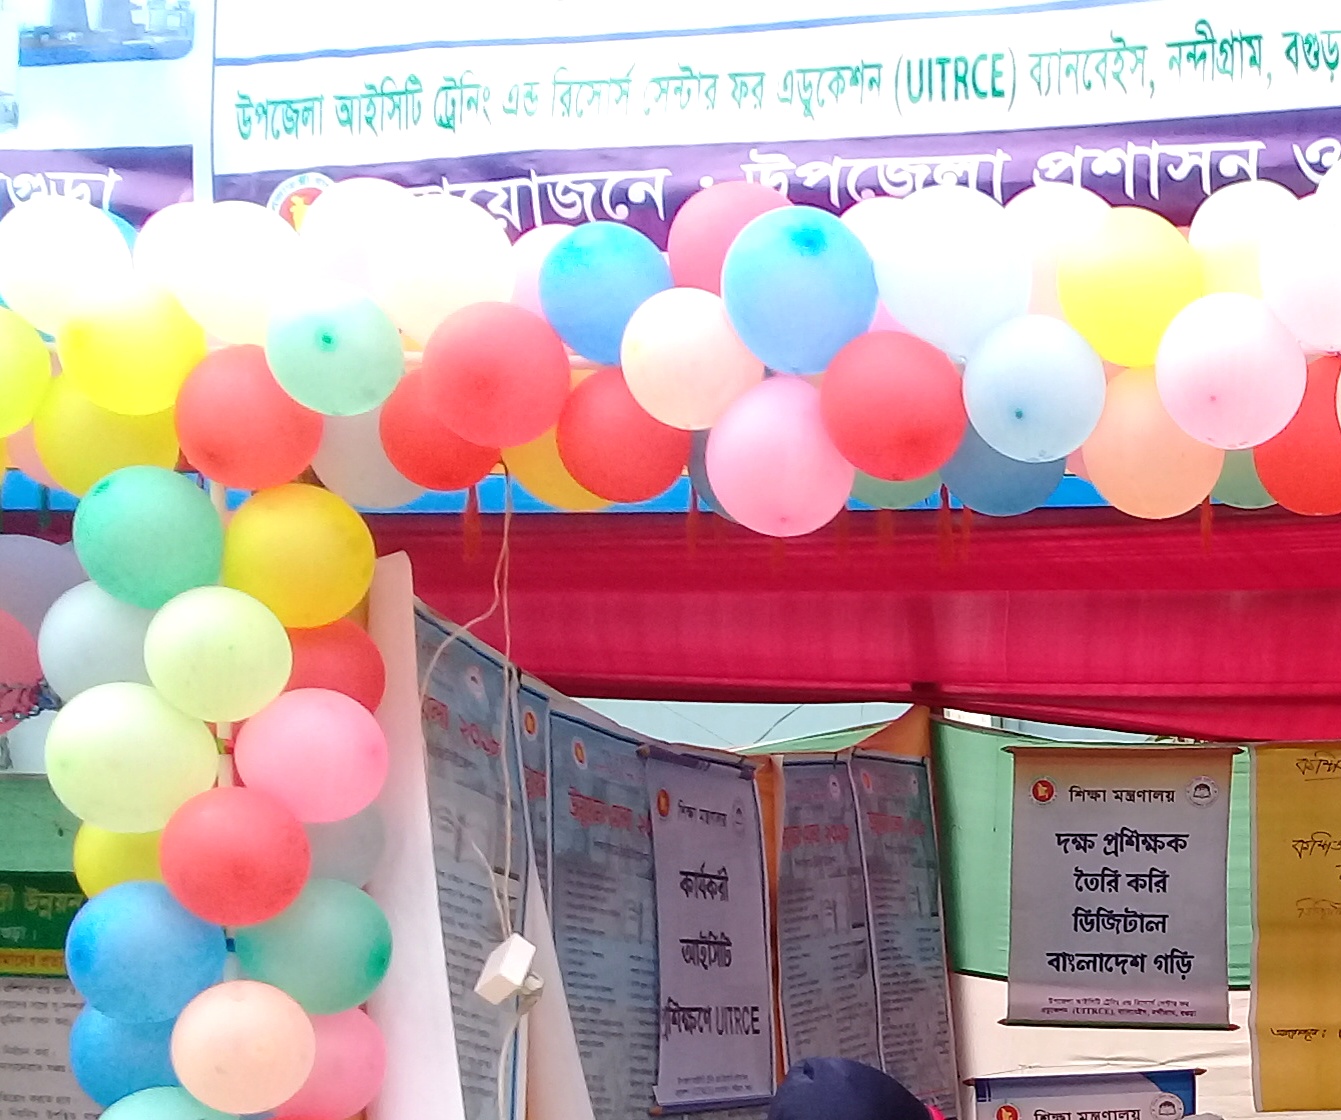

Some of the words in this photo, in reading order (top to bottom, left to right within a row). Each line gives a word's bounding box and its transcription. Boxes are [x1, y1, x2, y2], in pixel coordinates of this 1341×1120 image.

[236, 90, 323, 140] উপজেলা
[333, 73, 423, 137] আইসিটি
[730, 70, 765, 112] ফর
[776, 58, 883, 121] এডুকেশন
[894, 46, 1016, 115] (UITRCE)
[1068, 785, 1107, 803] শিক্ষা
[1055, 832, 1098, 855] দক্ষ
[1103, 826, 1190, 857] প্রশিক্ষক
[1073, 866, 1122, 894] তৈরি
[1126, 867, 1170, 894] করি
[1072, 906, 1169, 935] ডিজিটাল
[1046, 951, 1147, 975] বাংলাদেশ
[1153, 947, 1195, 980] গড়ি
[716, 1006, 761, 1036] UITRCE
